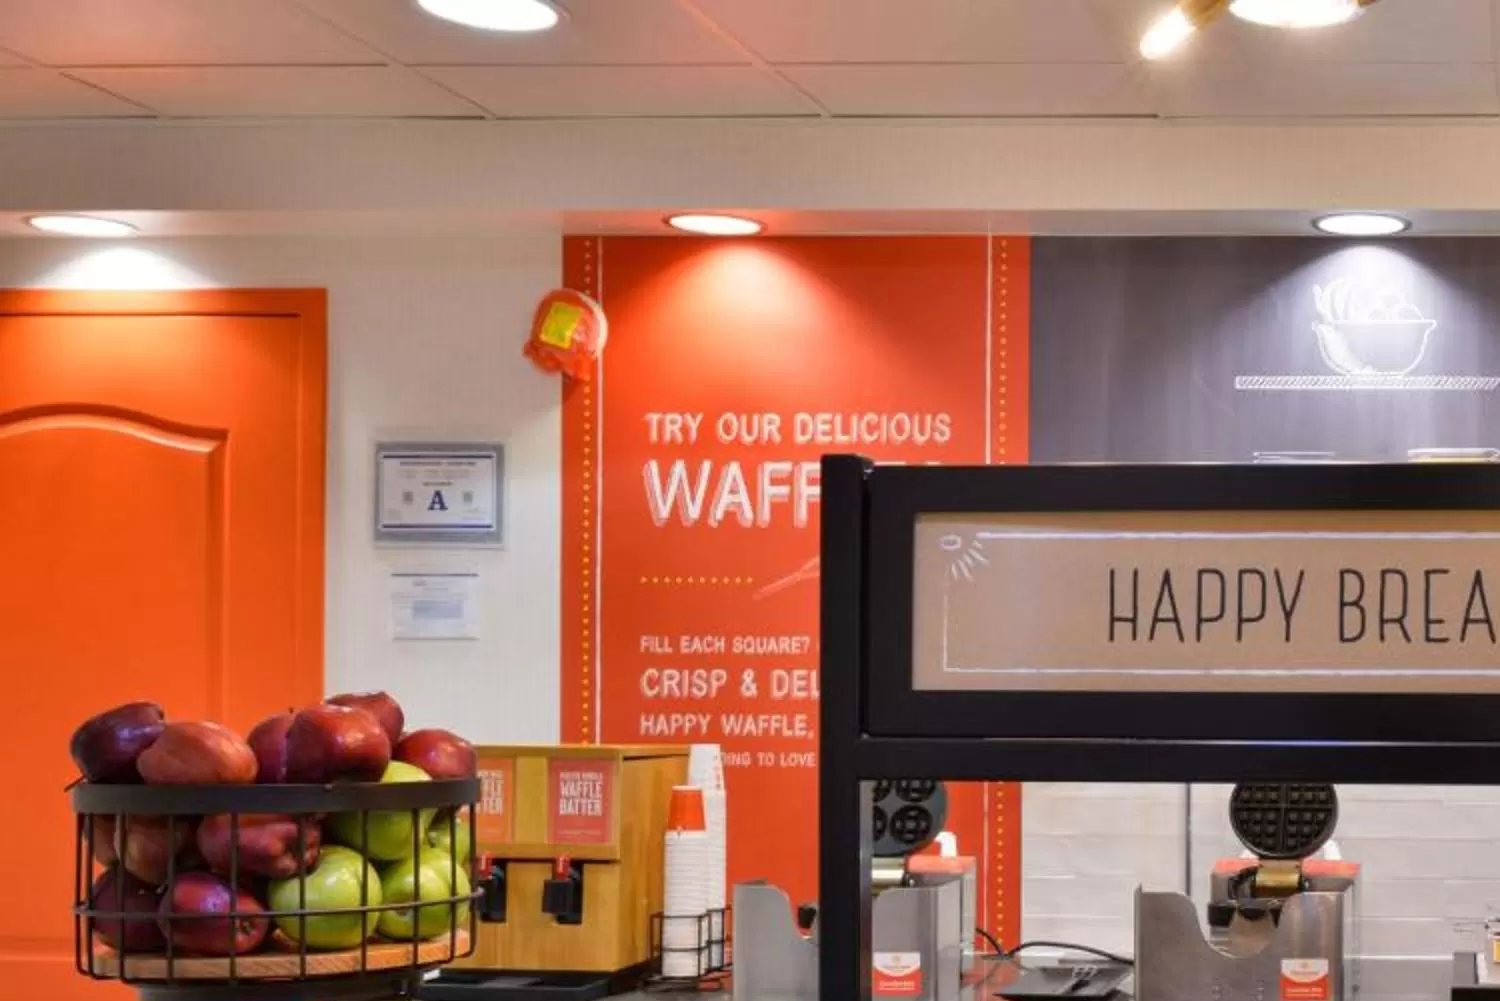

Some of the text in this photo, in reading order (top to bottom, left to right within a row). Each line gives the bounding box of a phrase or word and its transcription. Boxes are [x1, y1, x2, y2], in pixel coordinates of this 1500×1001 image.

[645, 412, 953, 444] TRY OUR DELICIOUS
[427, 489, 449, 511] A
[643, 458, 821, 528] WAFF
[1108, 568, 1304, 643] HAPPY
[640, 635, 811, 655] FILL EACH SQUARE?
[640, 667, 820, 699] CRISP & DEL
[640, 713, 814, 740] HAPPY WAFFLE,
[757, 751, 775, 767] TO
[780, 751, 816, 768] LOVE
